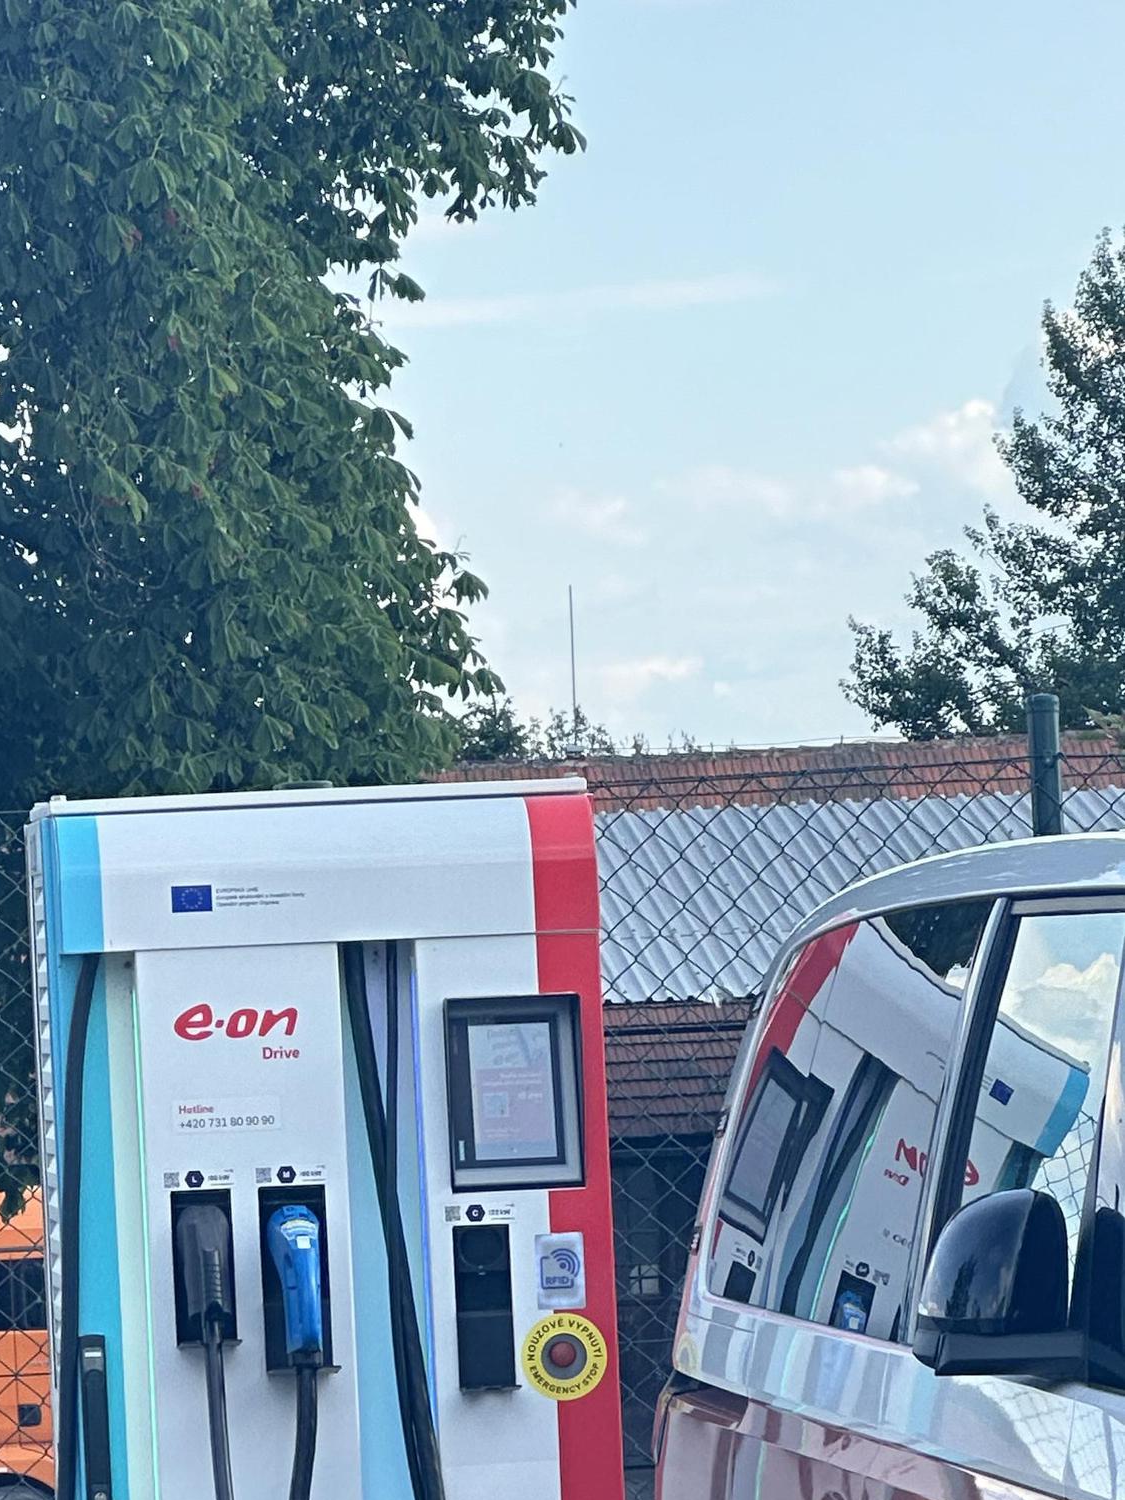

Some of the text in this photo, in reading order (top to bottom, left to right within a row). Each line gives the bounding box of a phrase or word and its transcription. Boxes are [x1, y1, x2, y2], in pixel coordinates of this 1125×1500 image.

[262, 1046, 300, 1060] Drive
[178, 1105, 214, 1114] Hotline
[179, 1115, 275, 1129] +420 731 80 90 90
[544, 1276, 570, 1286] RFID
[527, 1318, 603, 1361] NOUZOVÉ VYPNUTÍ
[529, 1362, 599, 1394] EMERGENCY STOP
